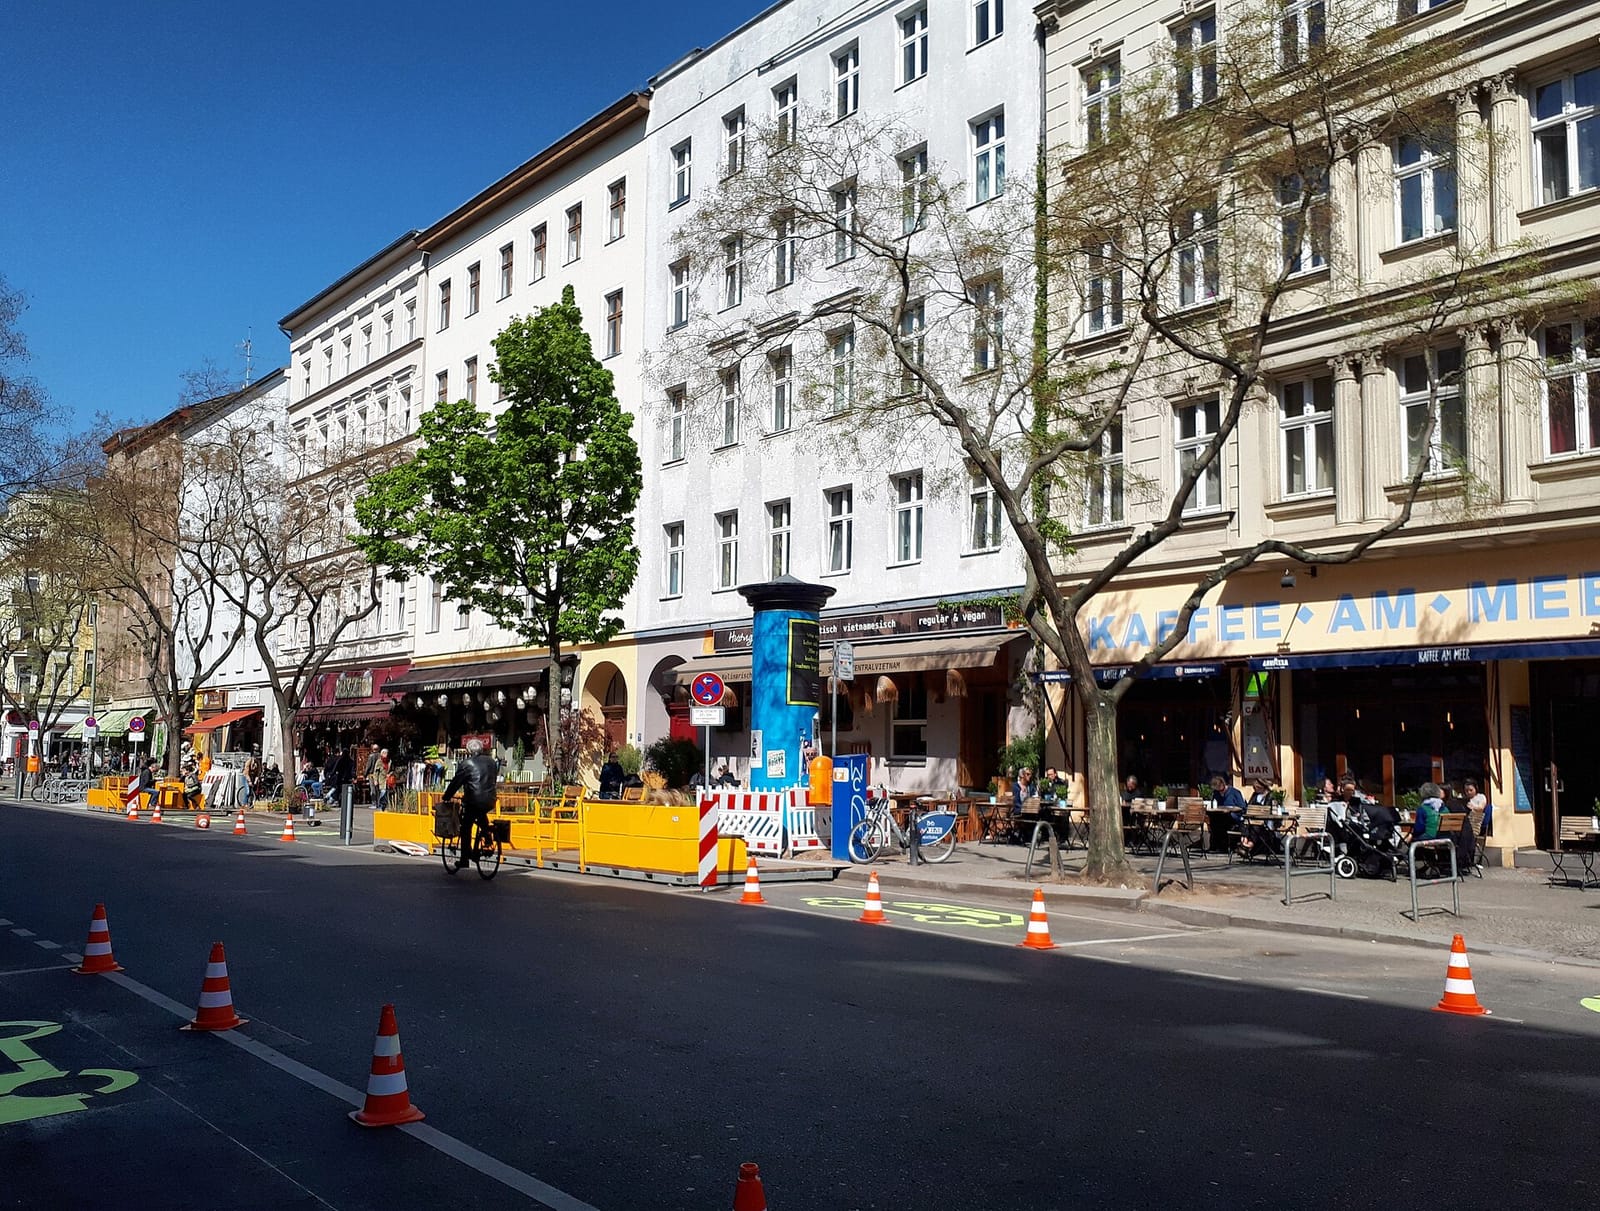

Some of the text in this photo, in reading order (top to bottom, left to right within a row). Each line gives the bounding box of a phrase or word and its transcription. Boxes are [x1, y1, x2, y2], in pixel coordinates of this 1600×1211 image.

[819, 625, 838, 635] tisch
[842, 619, 897, 633] vietnamesisch
[953, 612, 959, 623] &
[962, 611, 986, 623] vegan
[1088, 601, 1281, 650] KAFFEE
[1326, 587, 1417, 634] AM
[1418, 648, 1470, 663] KAFFEE AM MEER
[854, 660, 901, 671] ENTRALVIETNAM
[1248, 766, 1268, 774] BAR
